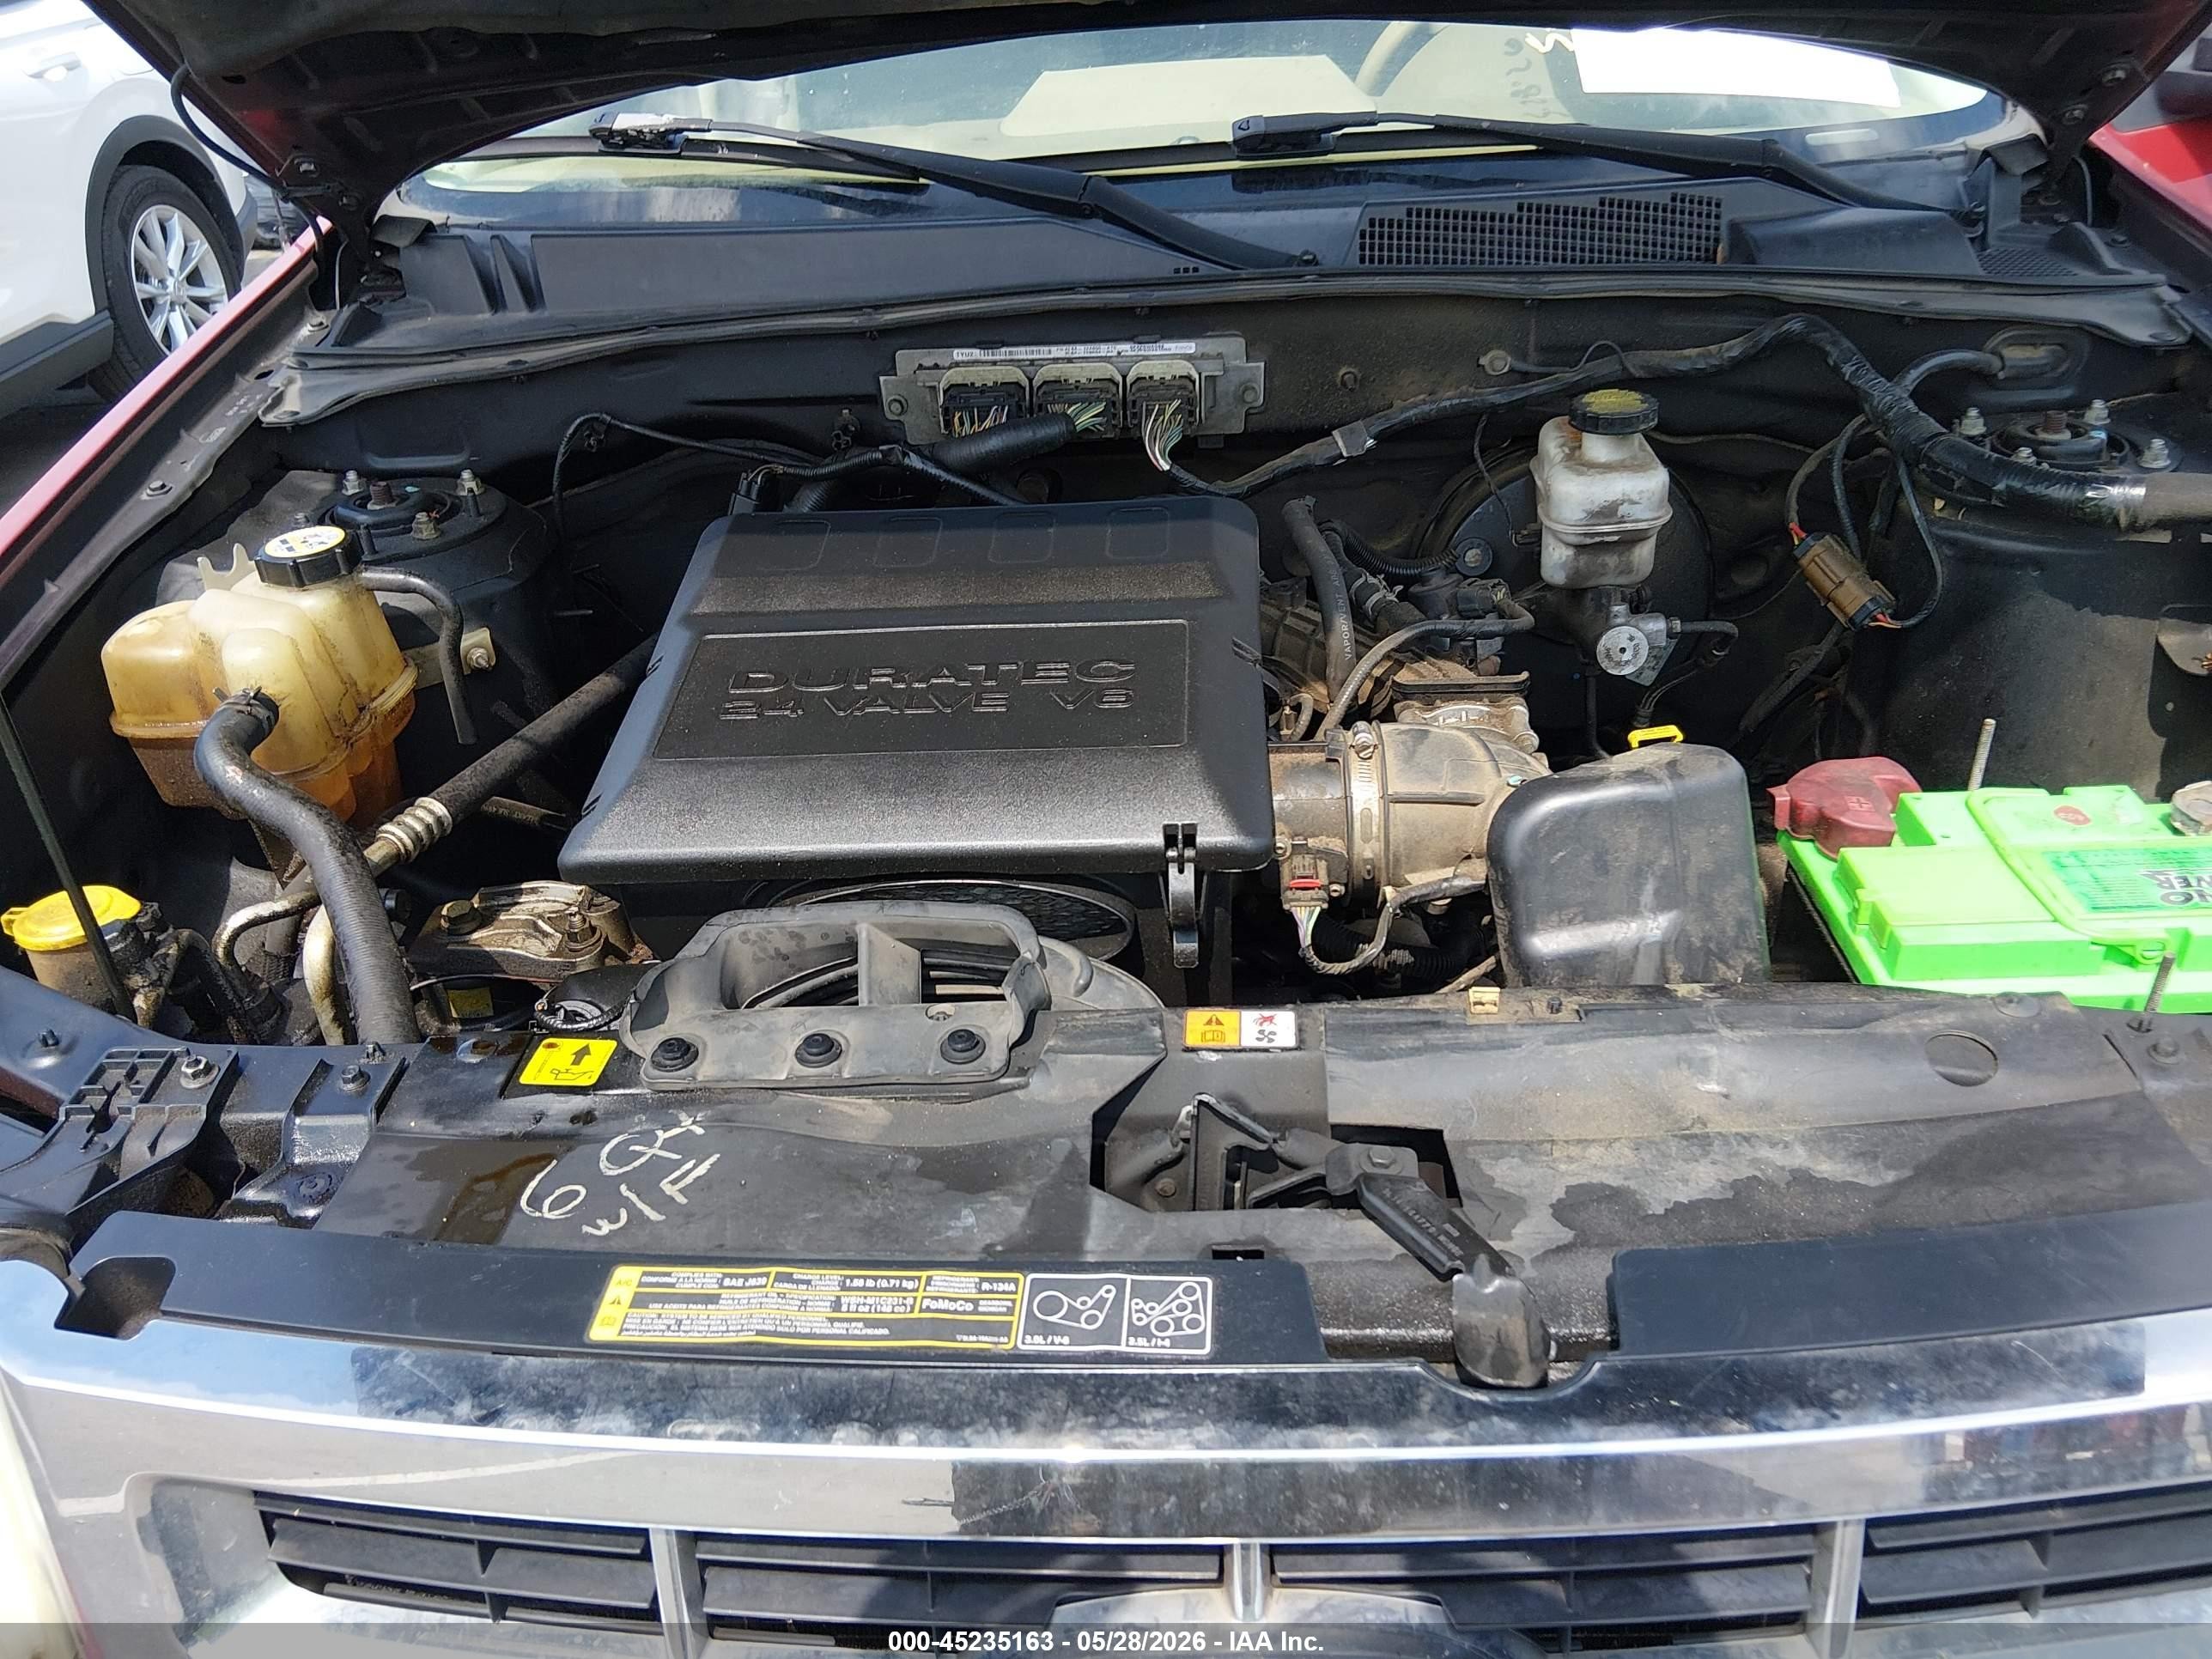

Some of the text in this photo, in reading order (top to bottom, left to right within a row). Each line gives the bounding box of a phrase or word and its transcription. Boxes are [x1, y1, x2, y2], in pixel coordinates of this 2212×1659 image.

[1336, 592, 1352, 661] VAPOR/VENT
[728, 661, 1135, 694] DURATEC
[720, 688, 1135, 720] 24 VALVE V6
[520, 1158, 586, 1219] 6
[723, 1277, 744, 1286] SAE
[866, 1278, 876, 1287] lb
[902, 1279, 919, 1290] kg)
[981, 1281, 1017, 1291] R-134A
[921, 1297, 975, 1311] FoMoCo
